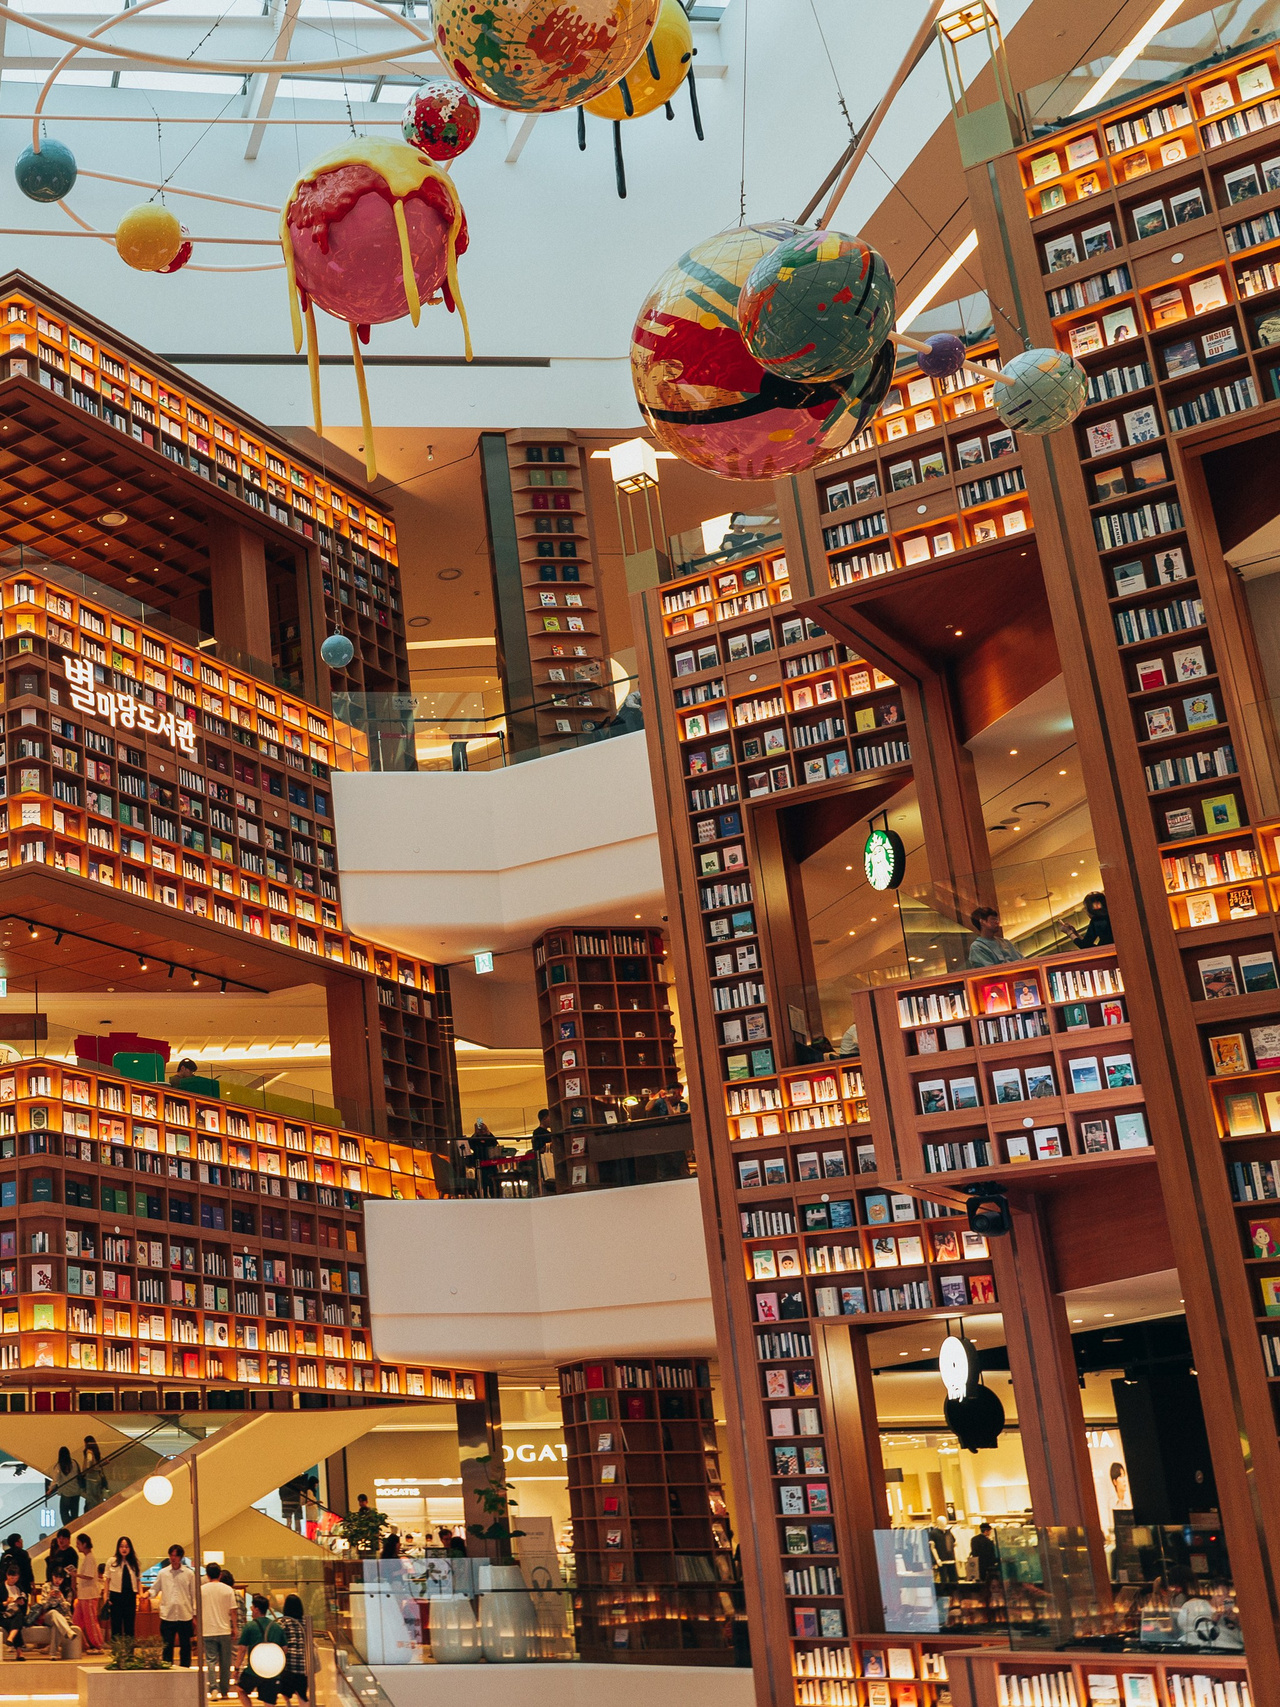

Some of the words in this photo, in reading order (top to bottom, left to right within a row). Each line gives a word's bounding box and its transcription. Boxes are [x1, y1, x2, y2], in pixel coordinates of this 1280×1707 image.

[1205, 330, 1231, 343] INSIDE
[1208, 344, 1225, 356] OUT
[62, 655, 196, 754] 별마당도서관
[1085, 1431, 1114, 1448] IA
[376, 1488, 420, 1496] ROGATIS
